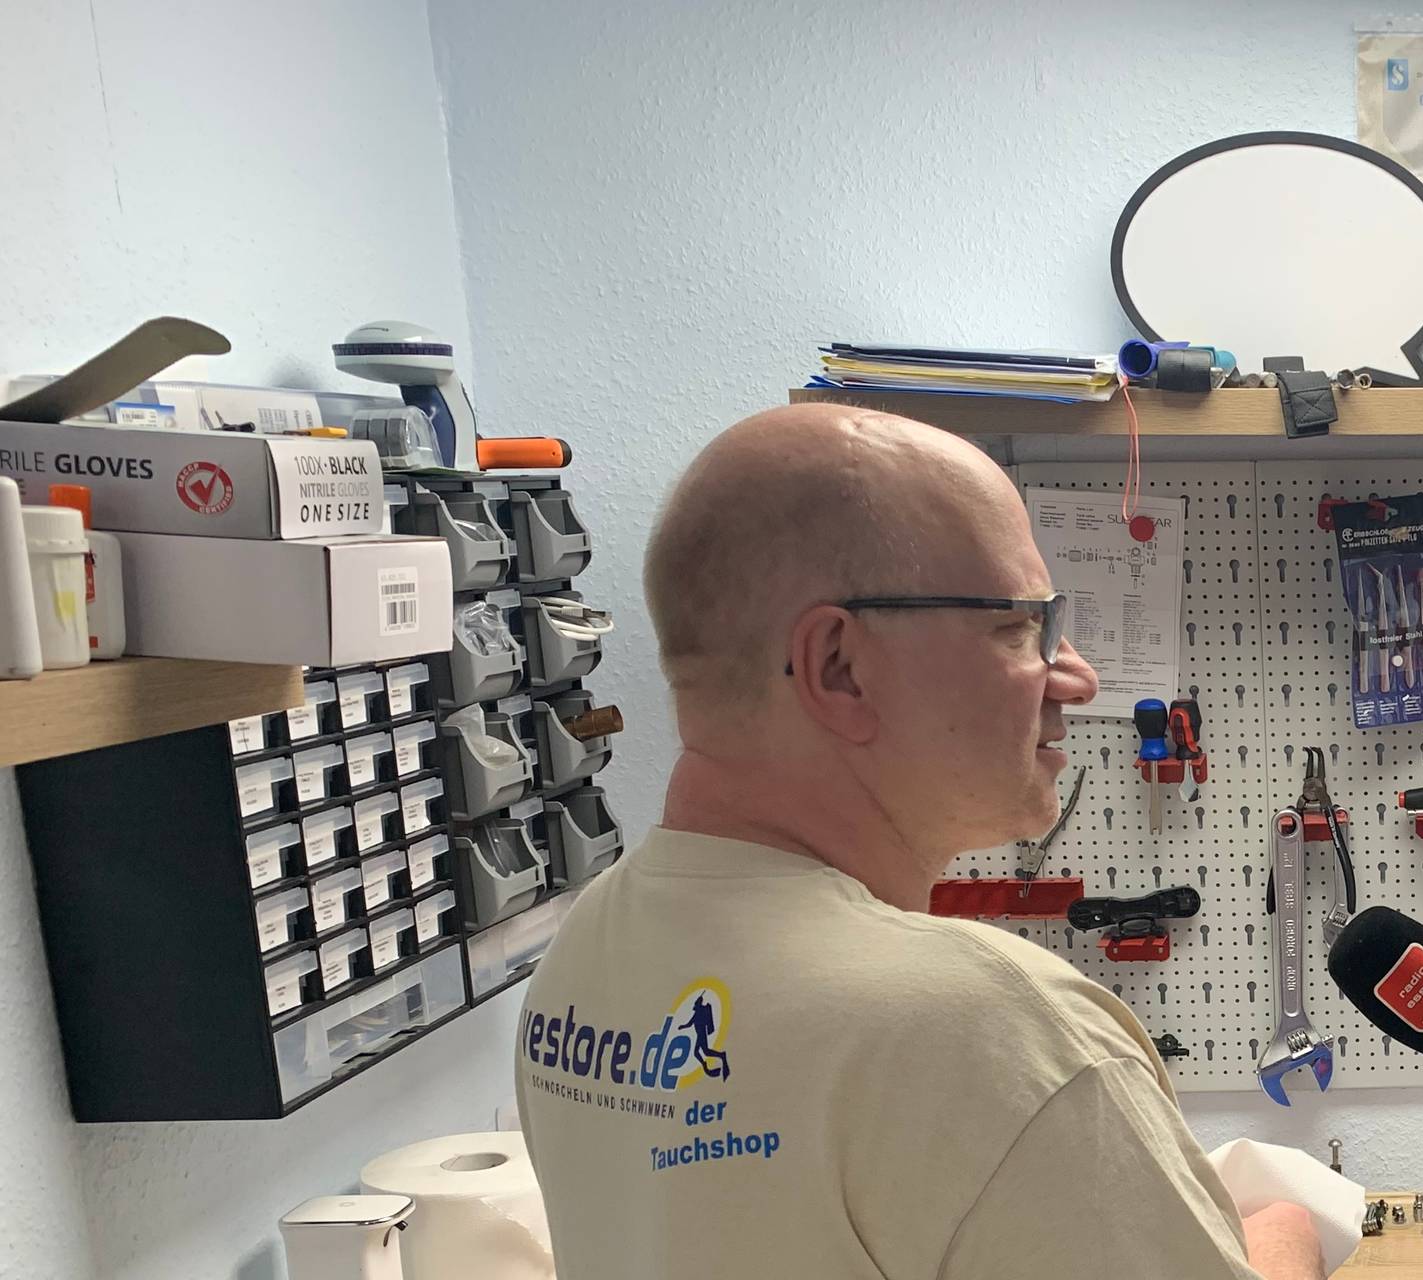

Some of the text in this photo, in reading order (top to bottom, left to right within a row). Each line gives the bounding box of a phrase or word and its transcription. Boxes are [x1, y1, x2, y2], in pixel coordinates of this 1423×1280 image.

[54, 453, 153, 480] GLOVES
[299, 481, 370, 499] NITRILE GLOVES
[300, 502, 370, 523] ONE SIZE
[1405, 630, 1423, 640] Stahl
[1285, 882, 1295, 909] STEEL
[1286, 919, 1296, 958] FORGED
[1287, 965, 1297, 991] DROP
[532, 1074, 676, 1120] SCHNORCHELN UND SCHWIMMEN
[685, 1100, 728, 1127] der
[651, 1130, 780, 1172] Tauchshop
